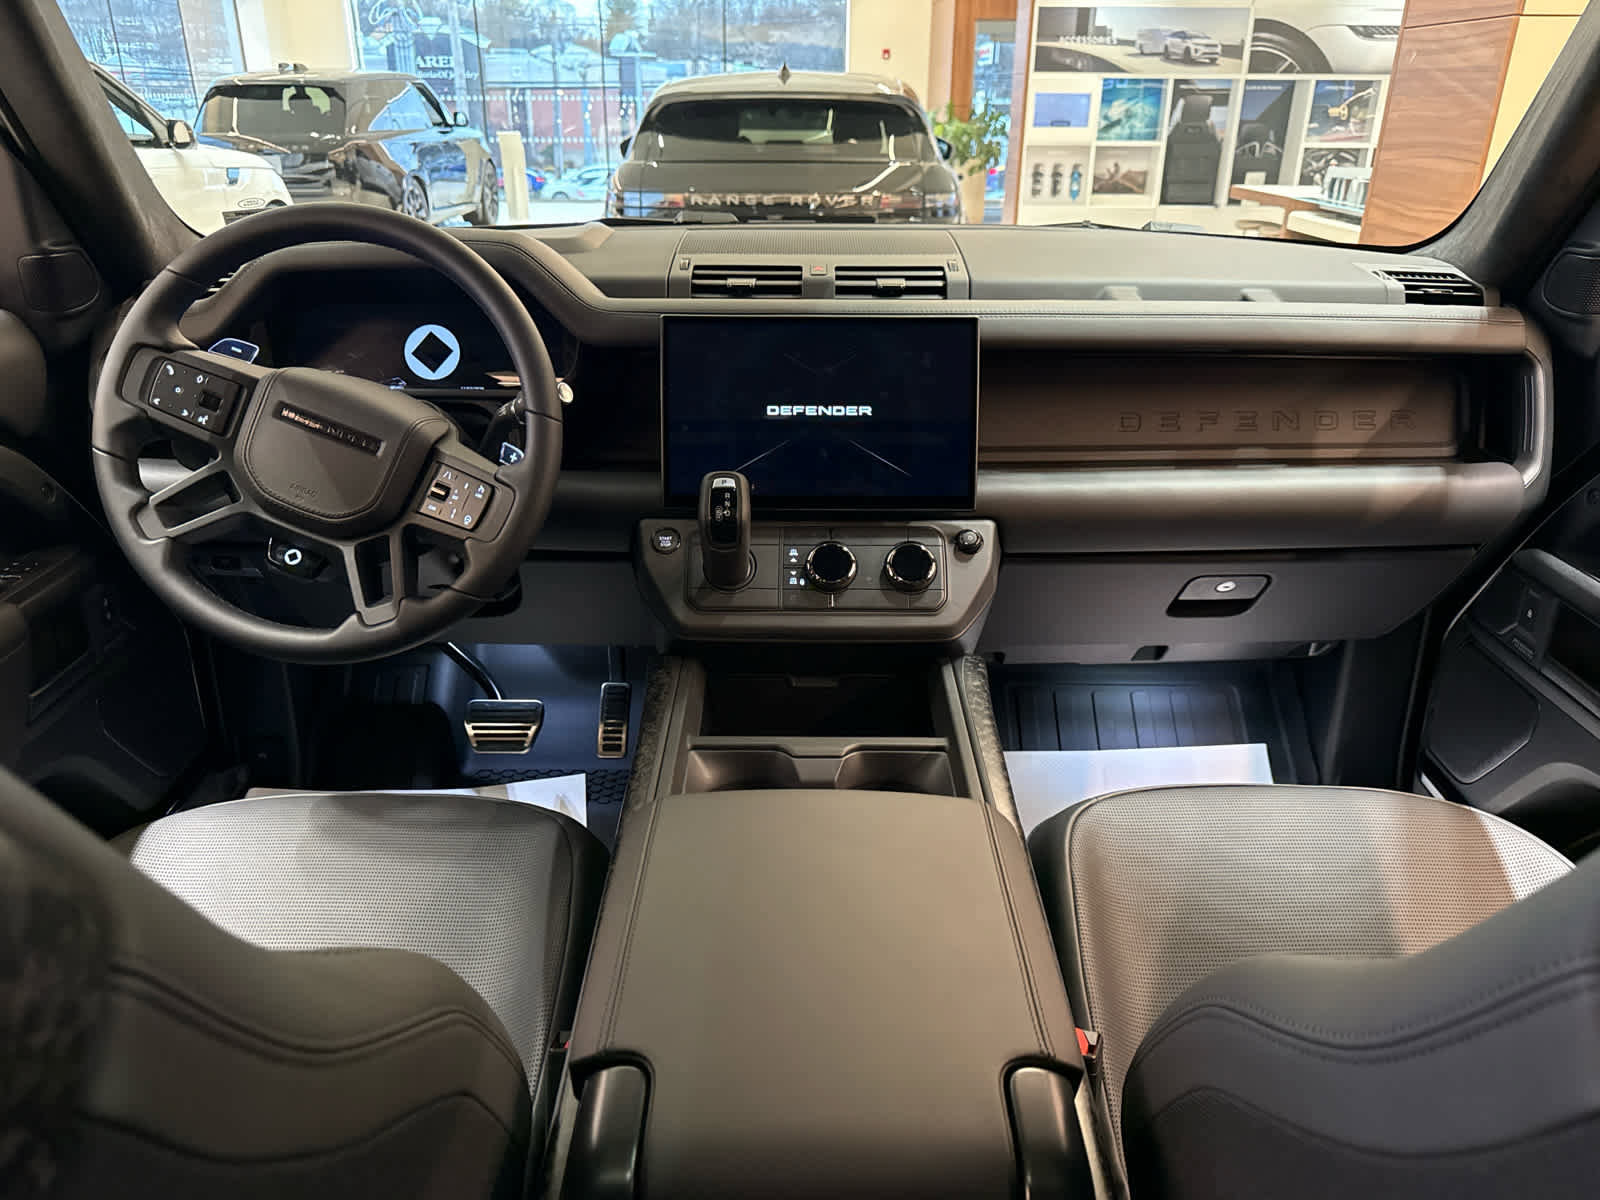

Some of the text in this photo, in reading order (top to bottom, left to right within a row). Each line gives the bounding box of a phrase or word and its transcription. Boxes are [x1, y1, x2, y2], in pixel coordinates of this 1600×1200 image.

[691, 193, 776, 206] RANGE
[766, 404, 873, 417] DEFENDER
[1117, 409, 1417, 432] DEFENDER
